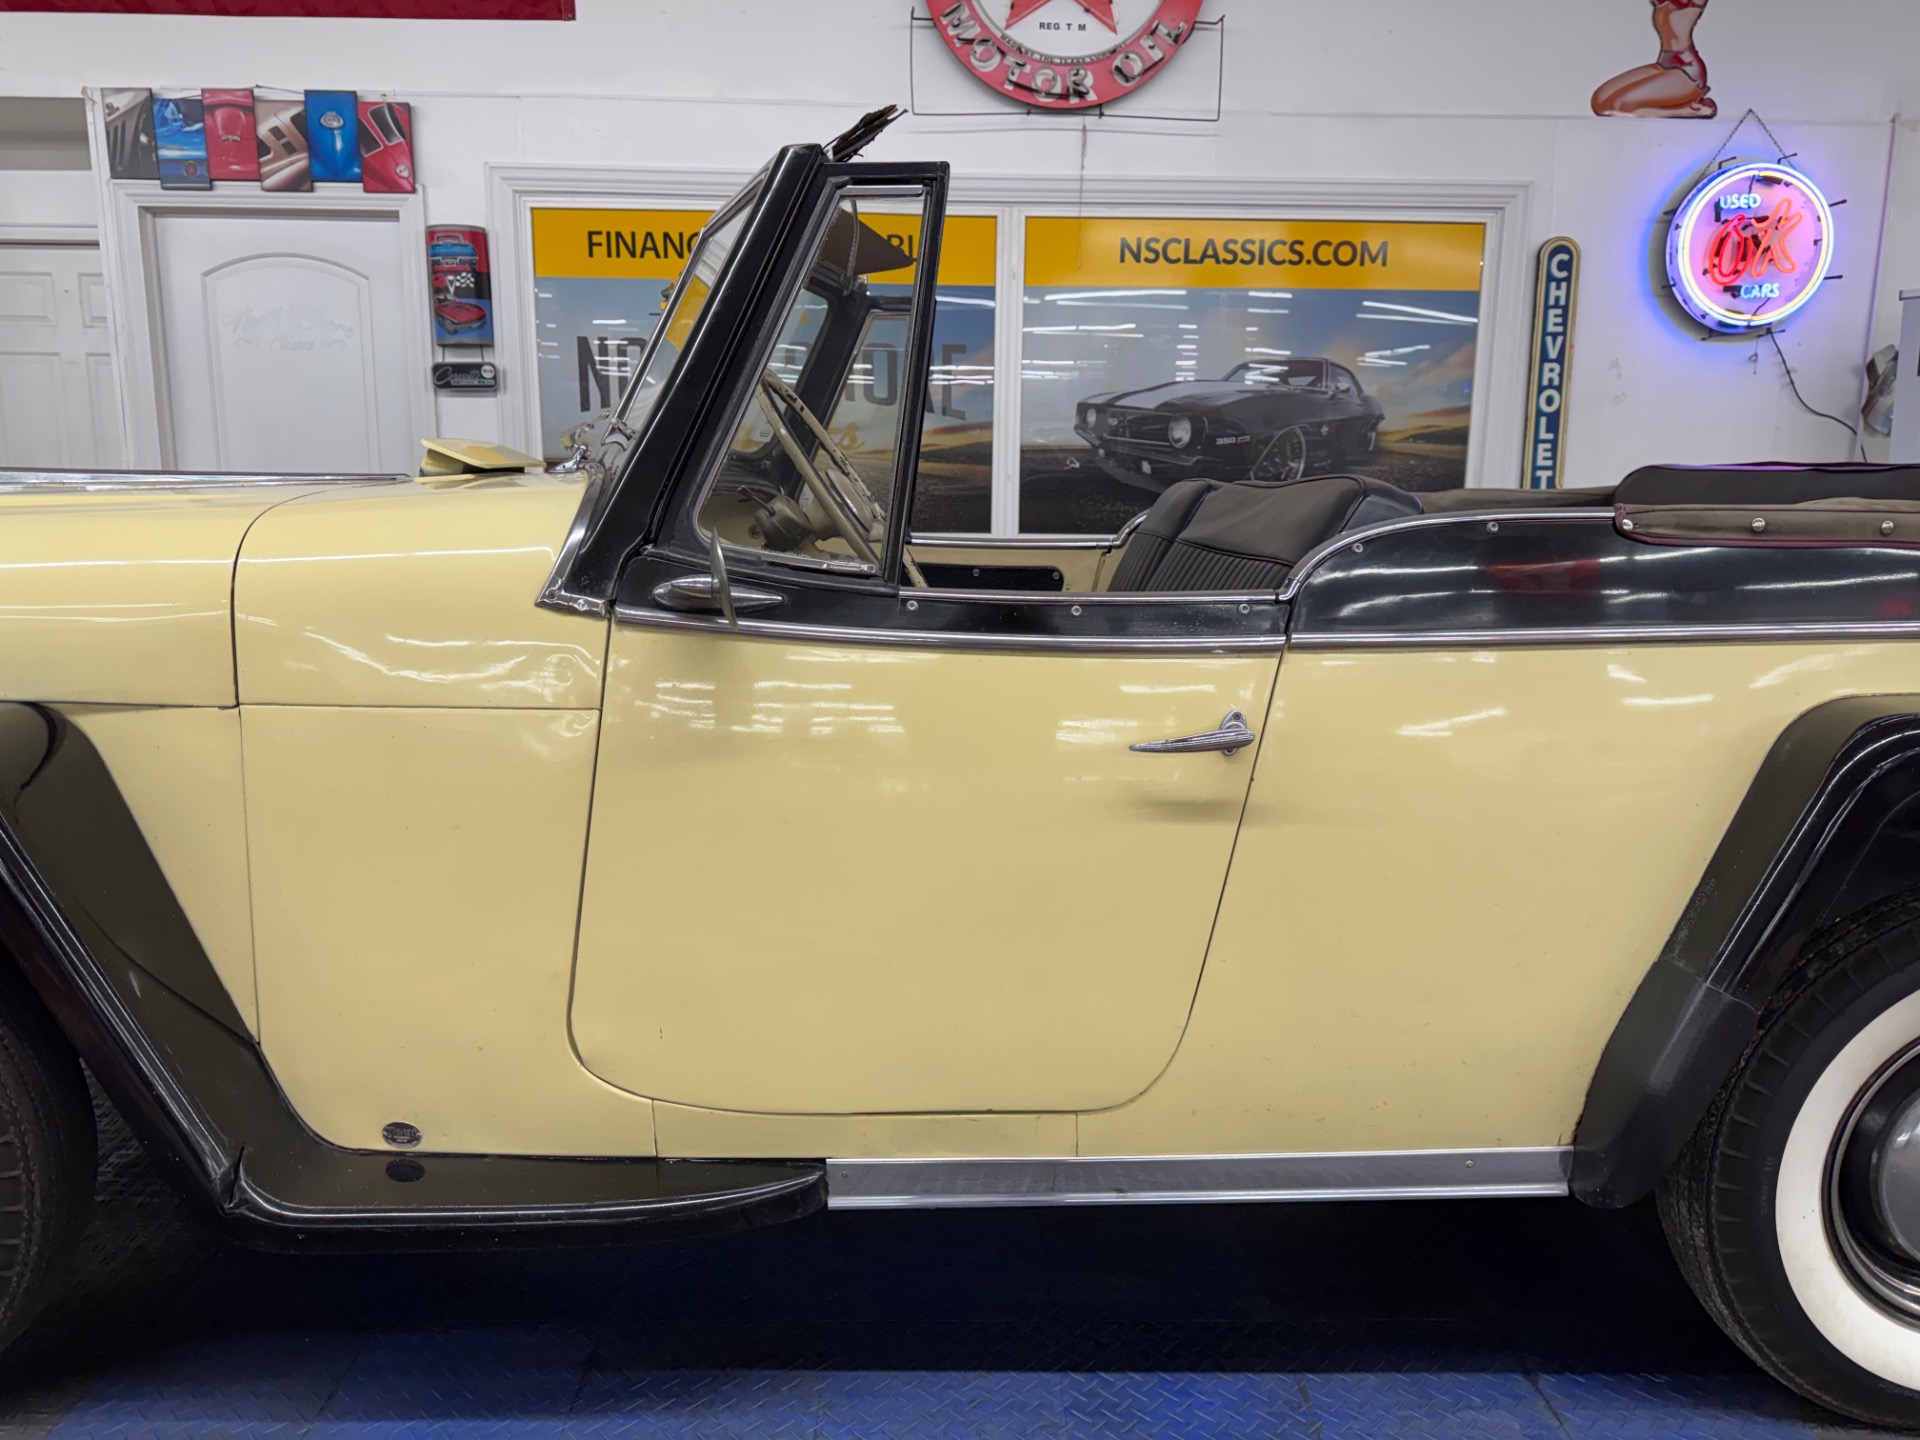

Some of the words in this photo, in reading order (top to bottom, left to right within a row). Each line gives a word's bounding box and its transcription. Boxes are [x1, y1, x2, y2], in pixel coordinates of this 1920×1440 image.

[941, 2, 1099, 104] MOTOR
[1112, 20, 1188, 87] OIL
[1719, 193, 1762, 209] USED
[1119, 236, 1389, 268] NSCLASSICS.COM
[1709, 198, 1804, 286] OK
[1739, 283, 1780, 299] CARS
[1535, 252, 1571, 489] CHEVROLET
